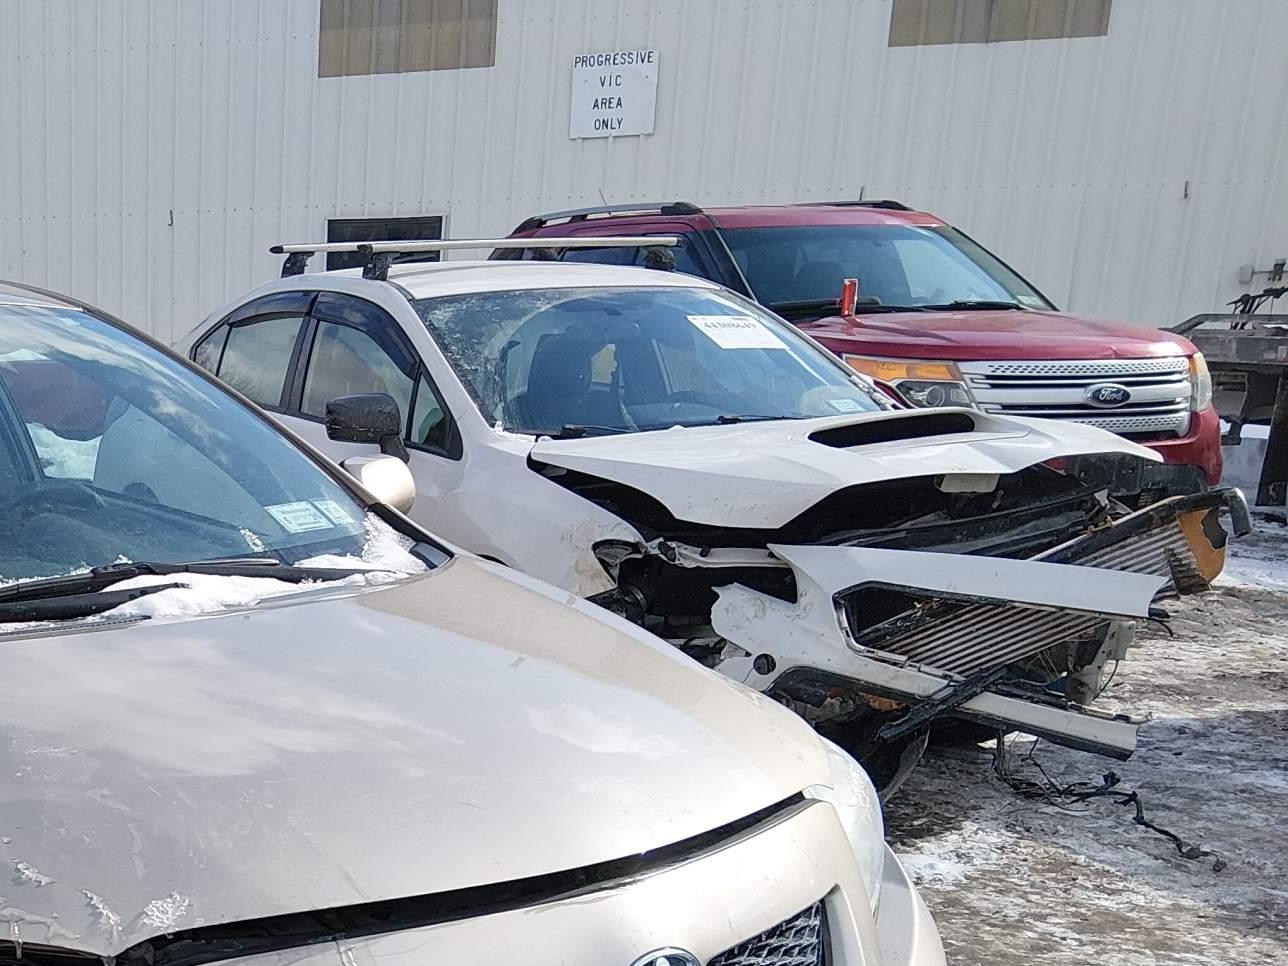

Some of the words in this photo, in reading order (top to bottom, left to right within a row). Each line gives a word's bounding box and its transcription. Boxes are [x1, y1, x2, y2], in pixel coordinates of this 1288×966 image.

[574, 51, 654, 68] PROGRESSIVE
[599, 74, 622, 87] VIC
[592, 96, 623, 110] AREA
[594, 118, 623, 130] ONLY
[1099, 387, 1124, 400] Ford
